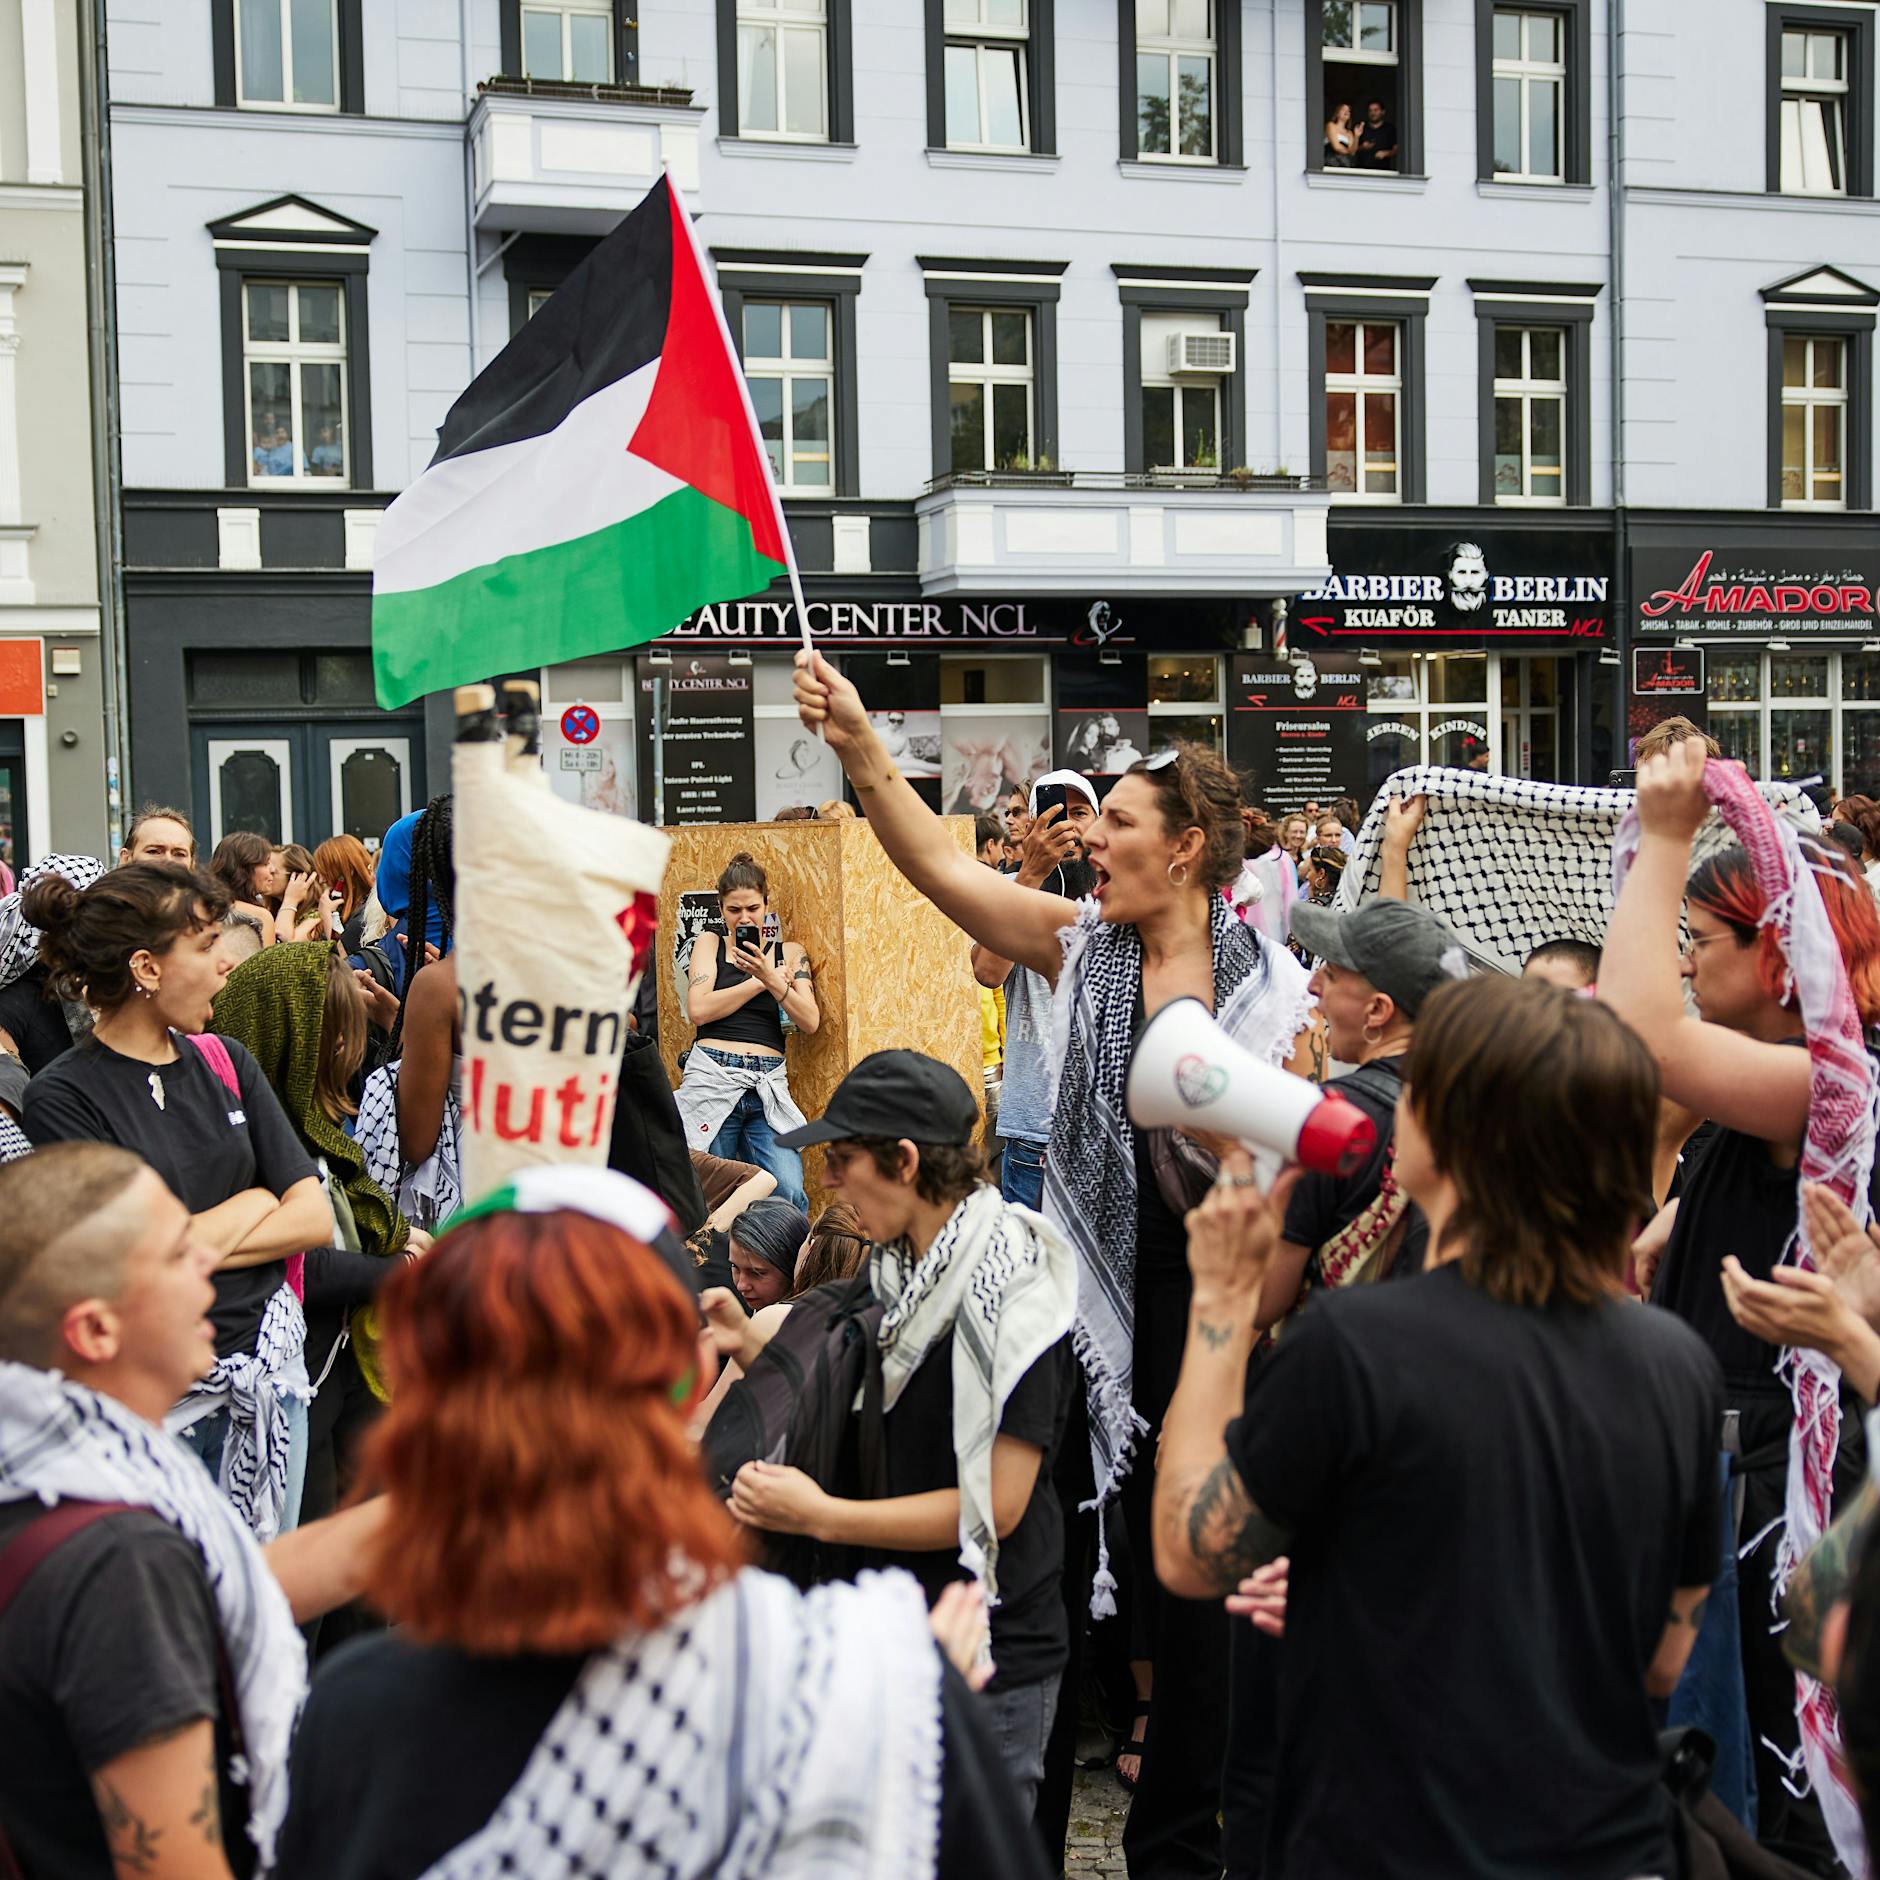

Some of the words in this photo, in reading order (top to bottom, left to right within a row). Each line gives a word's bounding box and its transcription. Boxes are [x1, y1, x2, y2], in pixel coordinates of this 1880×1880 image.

[1492, 576, 1608, 602] BERLIN
[1640, 550, 1874, 617] AMADOR
[663, 602, 794, 636] EAUTY
[805, 602, 952, 636] CENTER
[961, 605, 1037, 635] NCL
[1344, 605, 1437, 627] KUAFÖR
[1493, 609, 1567, 627] TANER
[1640, 619, 1669, 631] SHISHA
[1675, 619, 1700, 631] TABAK
[1706, 619, 1731, 631] KOHLE
[1802, 619, 1819, 631] UND
[1820, 619, 1873, 631] EINZELHANDEL
[1569, 618, 1605, 637] NCL
[681, 678, 724, 689] CENTER
[726, 678, 748, 689] NCL
[1242, 673, 1291, 685] BARBIER
[1320, 673, 1361, 684] BERLIN
[1336, 695, 1358, 706] NCL
[1429, 719, 1487, 742] KINDER
[714, 775, 733, 784] Light
[462, 1057, 617, 1149] luti
